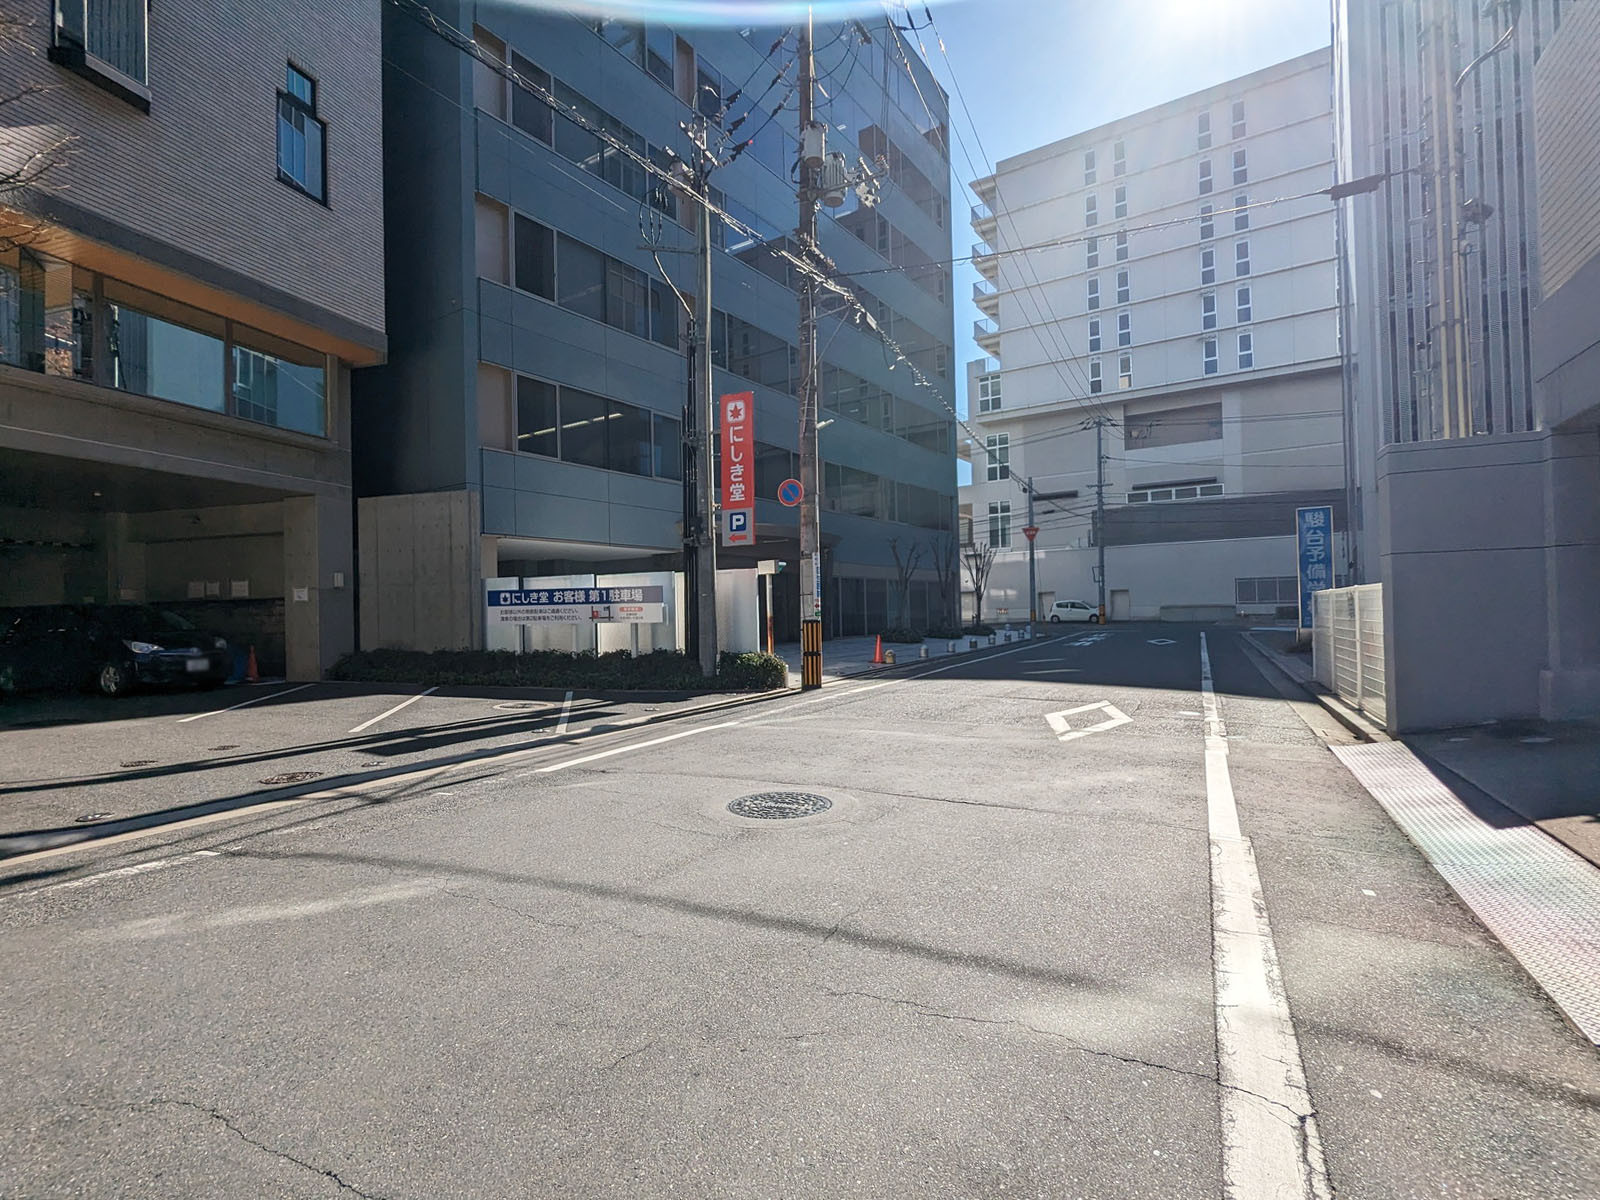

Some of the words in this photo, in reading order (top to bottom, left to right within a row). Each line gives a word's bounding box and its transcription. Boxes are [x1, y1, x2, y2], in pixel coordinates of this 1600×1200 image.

[729, 425, 745, 502] にしき堂
[732, 515, 744, 530] P
[1304, 511, 1327, 614] 駿台予備学
[512, 592, 549, 604] にしき堂
[553, 591, 585, 603] お客様
[588, 588, 643, 603] 第1駐車場
